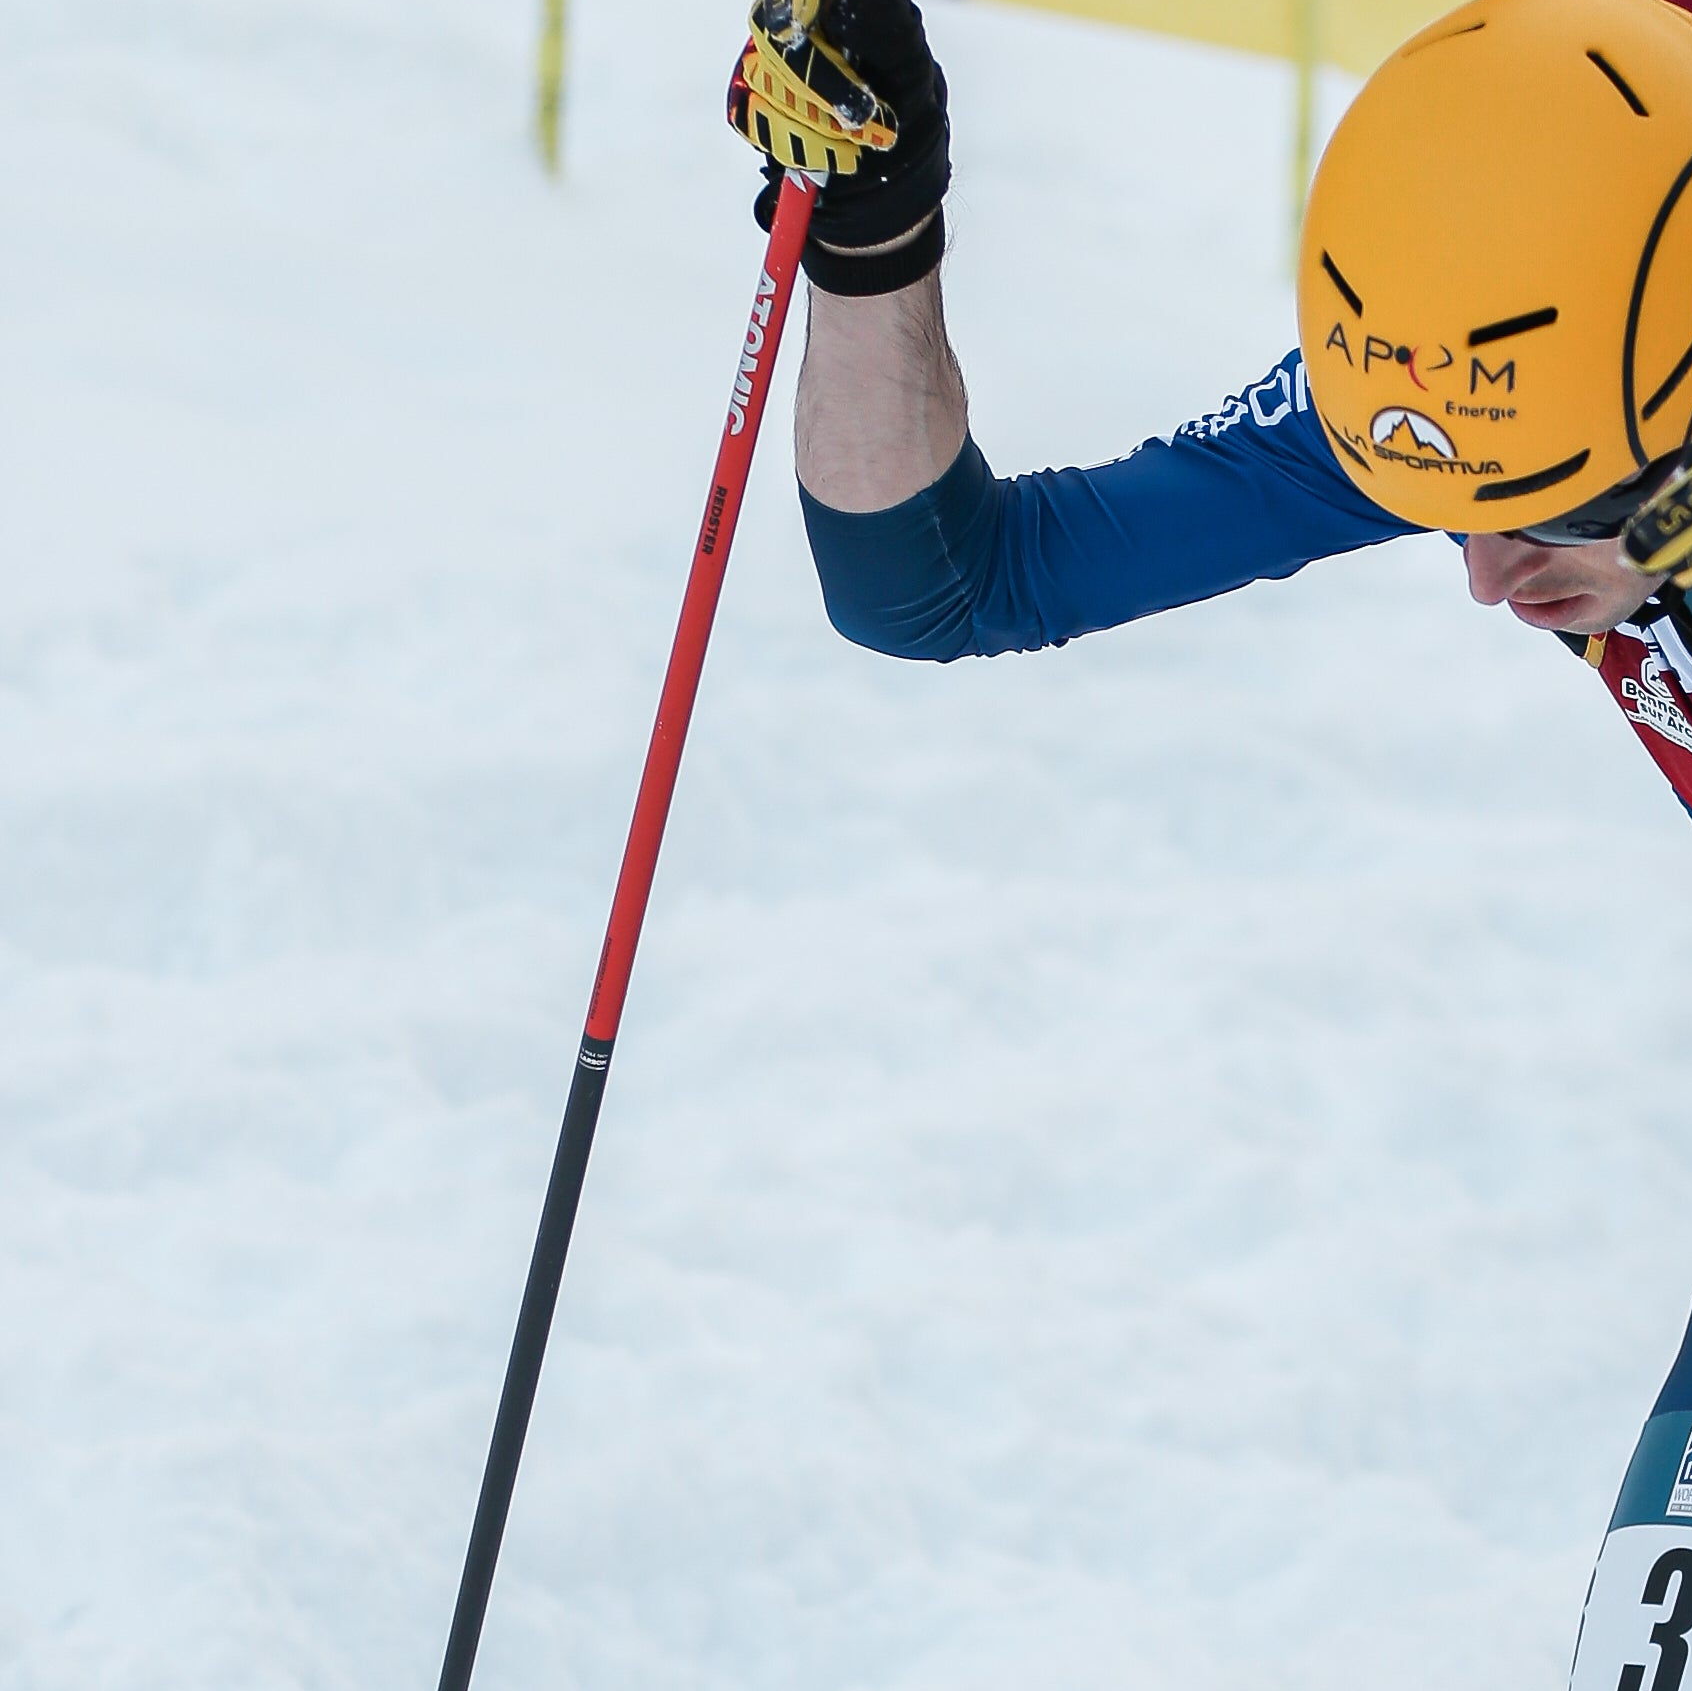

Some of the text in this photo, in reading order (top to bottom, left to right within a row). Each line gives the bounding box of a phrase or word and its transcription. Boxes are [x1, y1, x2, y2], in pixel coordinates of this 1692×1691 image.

[723, 267, 779, 437] ATOMIC
[1444, 399, 1518, 422] Energie
[1372, 442, 1505, 476] SPORTIVA
[701, 485, 729, 556] REDSTER
[1656, 501, 1692, 534] LA
[1639, 702, 1664, 721] sur
